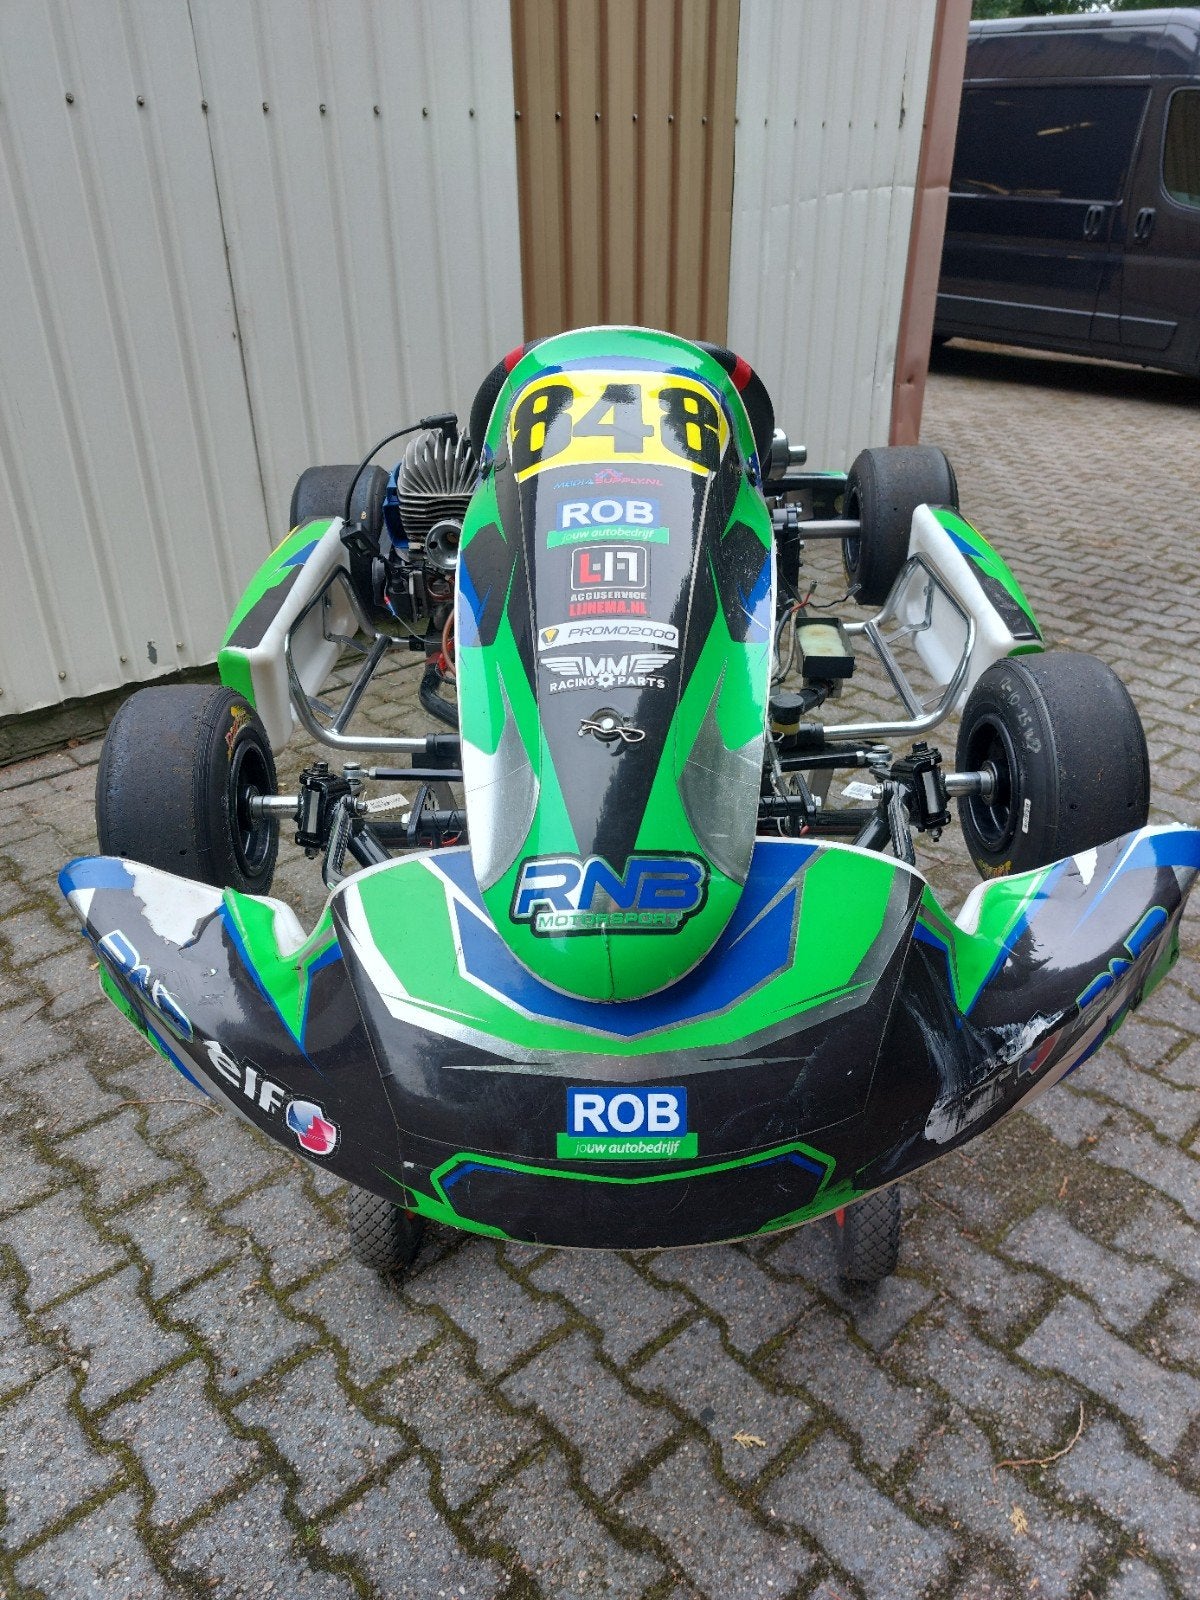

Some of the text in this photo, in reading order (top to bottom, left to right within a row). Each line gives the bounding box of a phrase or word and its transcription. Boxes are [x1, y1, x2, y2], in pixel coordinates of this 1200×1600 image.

[512, 384, 720, 474] 848
[562, 500, 654, 527] ROB
[561, 528, 655, 543] jouw autobedrijf
[570, 591, 647, 602] ACCUSERVICE
[568, 626, 676, 641] PROMO2000
[585, 656, 628, 676] MM
[550, 676, 665, 692] RACING PARTS
[516, 859, 701, 914] RNB
[538, 913, 679, 928] MOTORSPORT
[202, 1040, 285, 1114] elf
[574, 1093, 680, 1132] ROB
[575, 1140, 681, 1156] jouw autobedrijf
